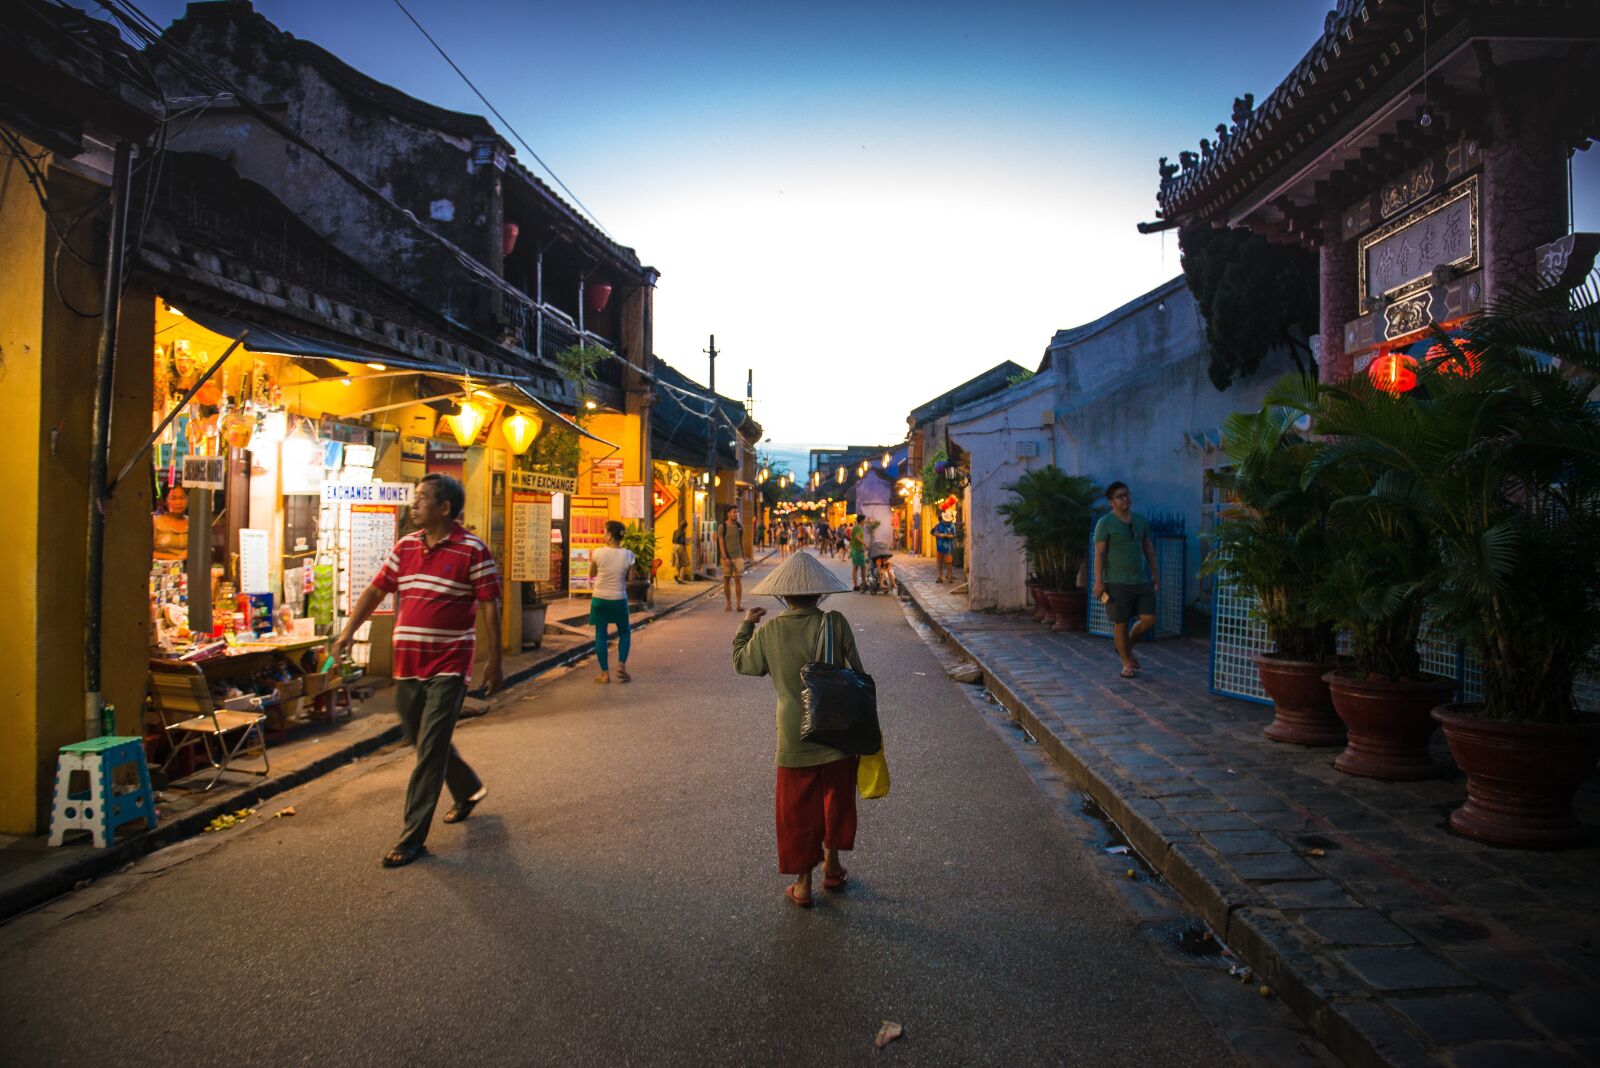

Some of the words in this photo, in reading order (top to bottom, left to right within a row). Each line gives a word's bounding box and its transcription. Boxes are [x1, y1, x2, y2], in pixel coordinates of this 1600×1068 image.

[537, 475, 575, 492] EXCHANGE
[327, 485, 373, 500] EXCHANGE
[378, 486, 409, 501] MONEY
